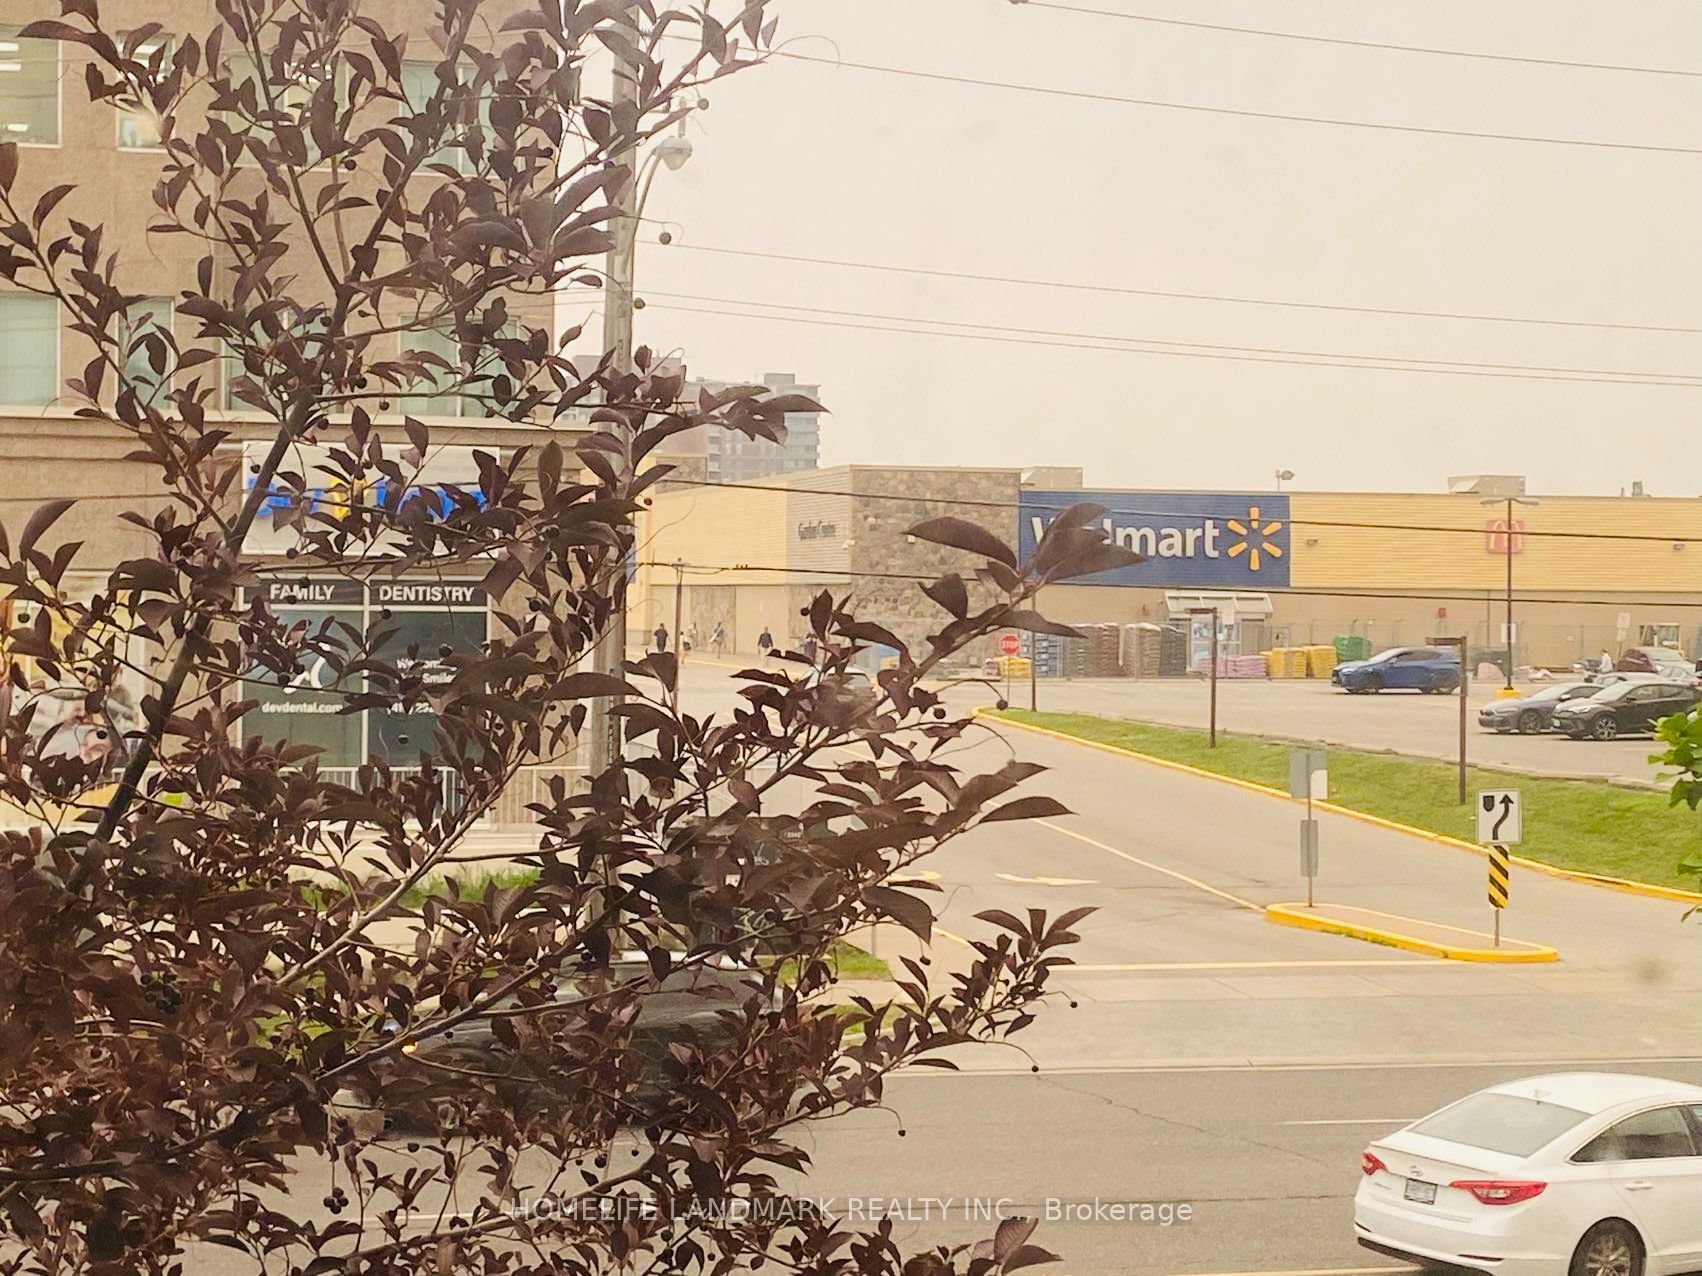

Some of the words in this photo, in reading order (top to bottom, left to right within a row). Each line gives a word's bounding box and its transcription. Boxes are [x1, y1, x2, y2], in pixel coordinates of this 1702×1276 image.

[1031, 517, 1220, 559] lmart
[270, 584, 335, 600] FAMILY
[379, 586, 475, 601] DENTISTRY
[1001, 640, 1019, 650] STOP
[261, 701, 344, 713] devdental.com
